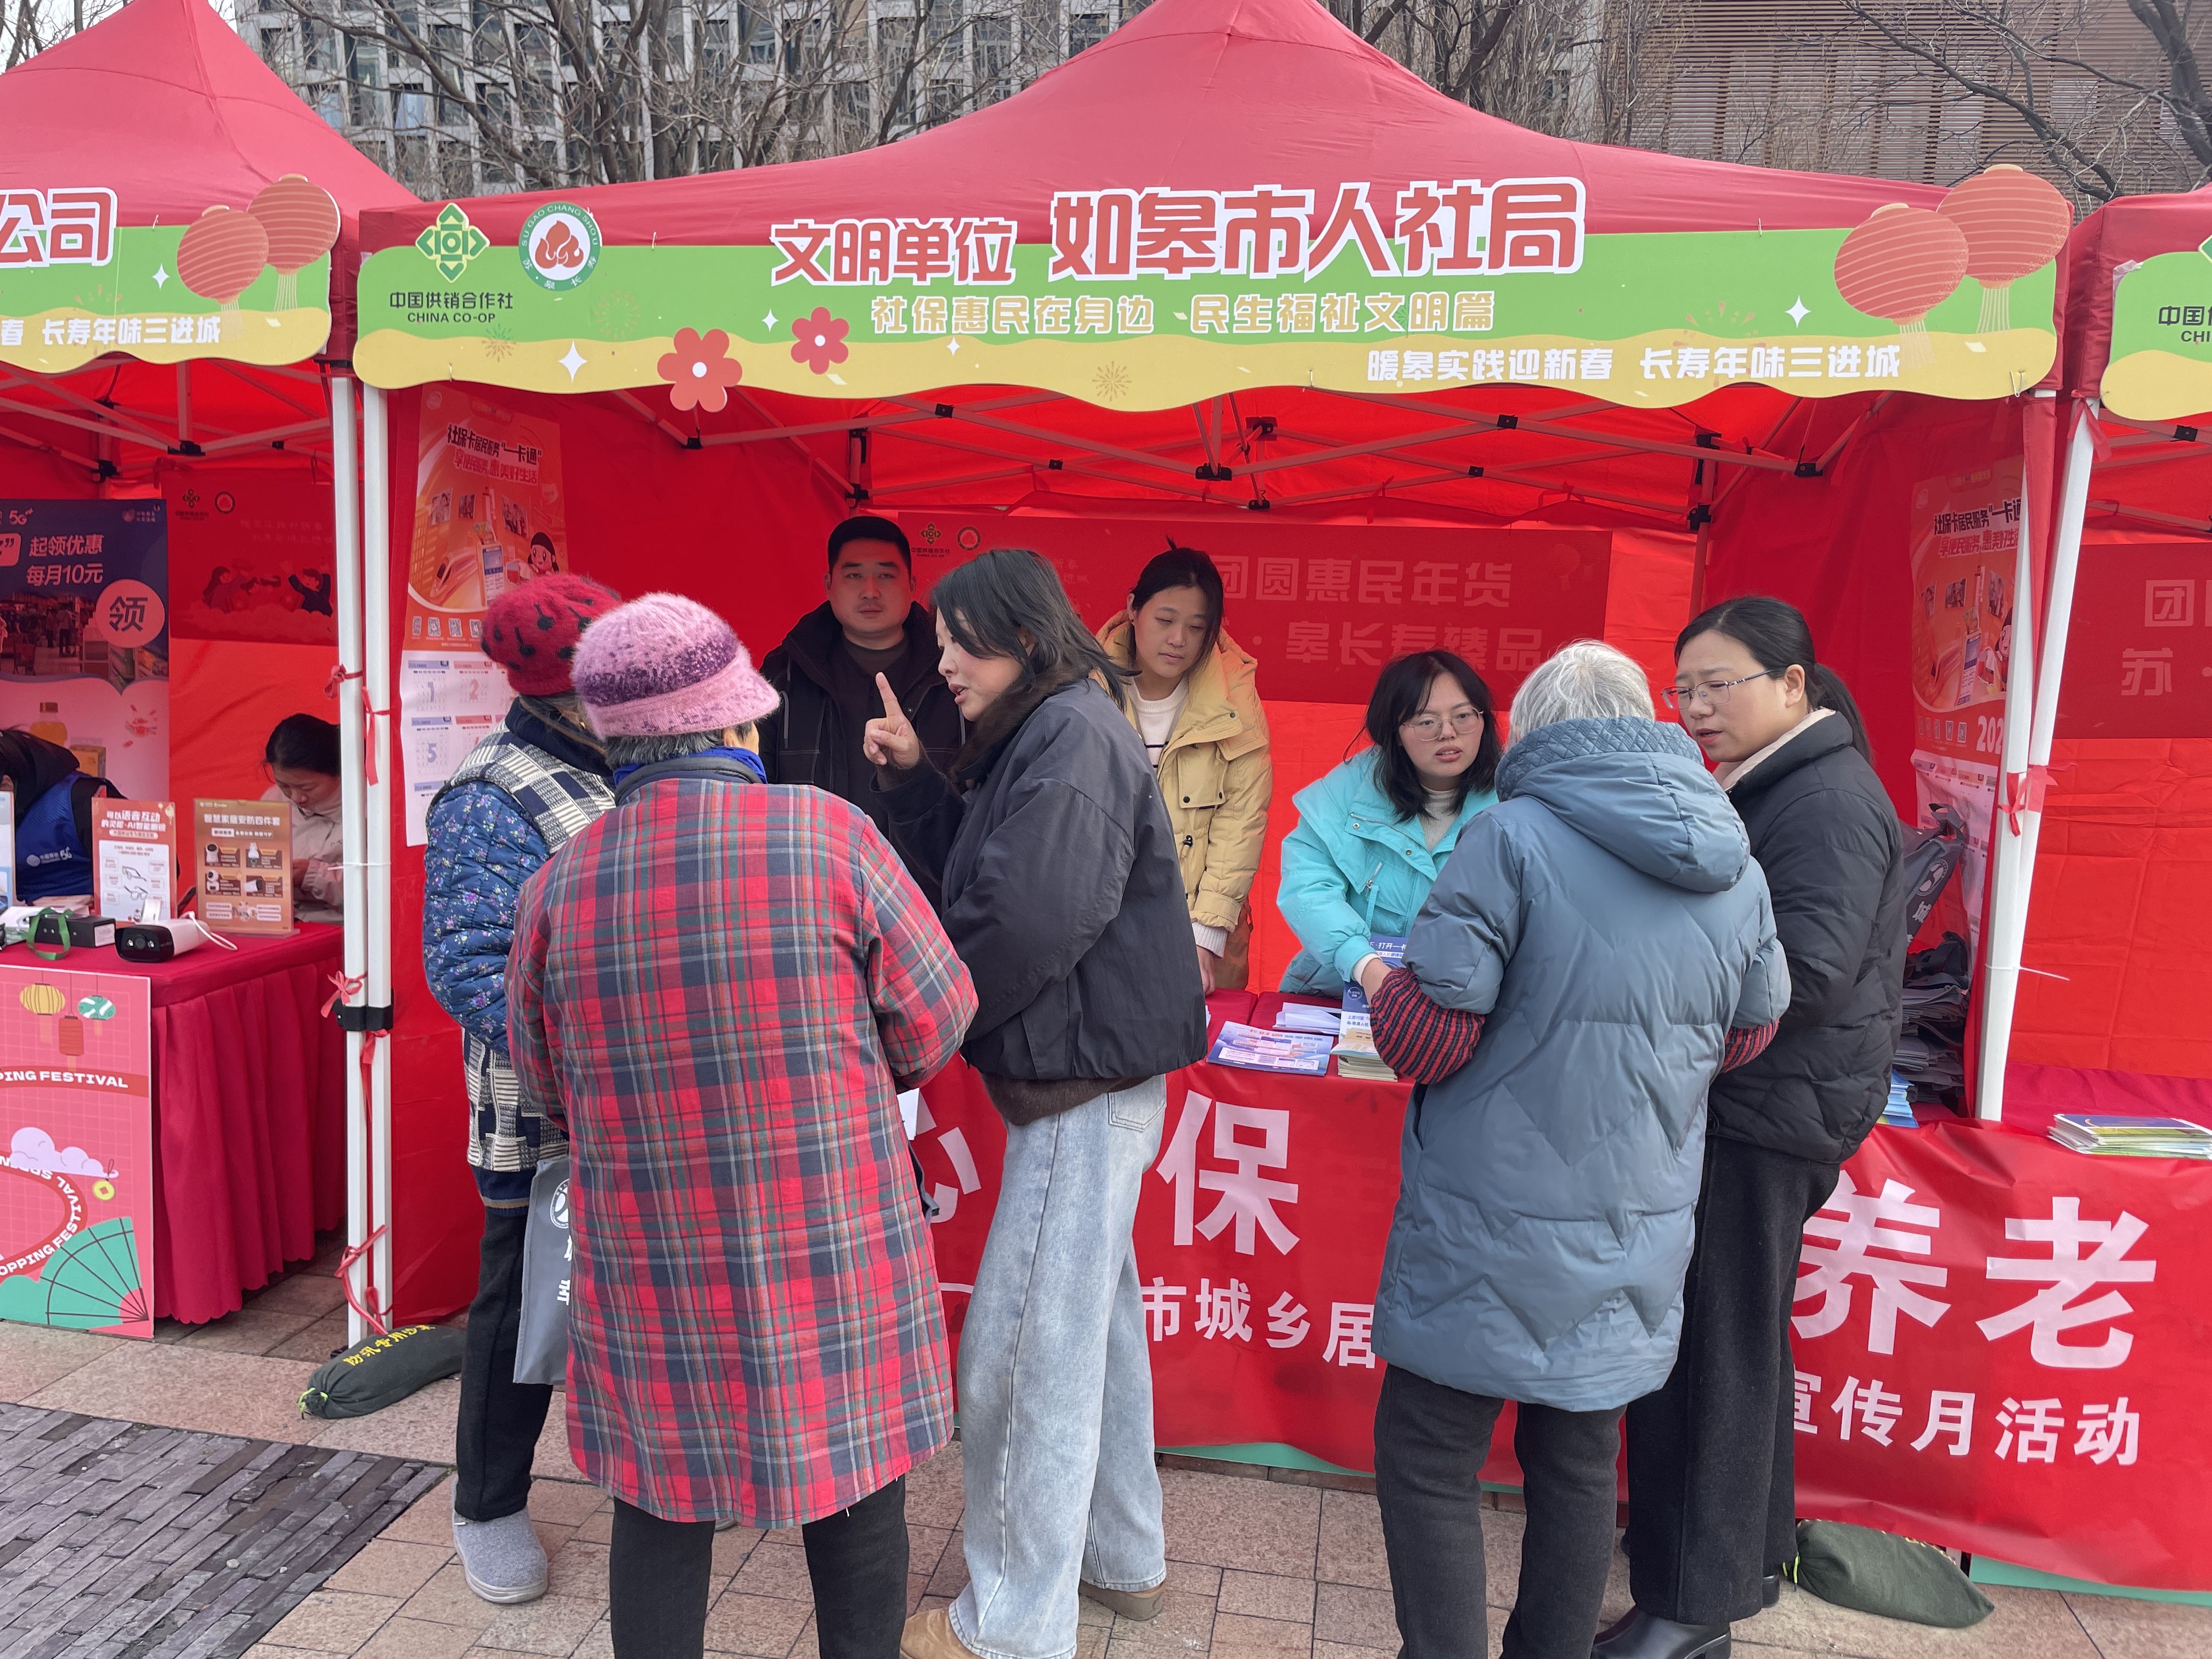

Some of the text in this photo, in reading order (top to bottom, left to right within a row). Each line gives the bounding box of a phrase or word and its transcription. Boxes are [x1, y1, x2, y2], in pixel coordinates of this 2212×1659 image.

[0, 188, 117, 268] 公司
[528, 210, 545, 228] GAO
[547, 205, 581, 216] CHANG
[582, 215, 598, 245] SHOU
[770, 177, 1586, 286] 文明单位 如皋市人社局
[390, 291, 513, 309] 中国供销合作社
[407, 312, 495, 323] CHINA CO-OP
[872, 291, 1495, 334] 社保惠民在身边 民生福祉文明篇
[2158, 306, 2212, 326] 中国
[42, 316, 221, 346] 长寿年味三进城
[2181, 330, 2212, 342] CHI
[1368, 345, 1900, 381] 暖皋实践迎新春 长寿年味三进城
[29, 534, 104, 557] 起领优惠
[26, 562, 104, 587] 每月10元
[1209, 555, 1513, 607] 团圆惠民年货
[109, 595, 148, 631] 领
[2144, 579, 2212, 627] 团
[40, 1070, 129, 1088] FESTIVAL
[52, 1176, 82, 1248] FESTIVAL
[1156, 1090, 1301, 1256] 保
[1790, 1170, 2157, 1369] 养老
[1141, 1277, 1376, 1369] 市城乡居
